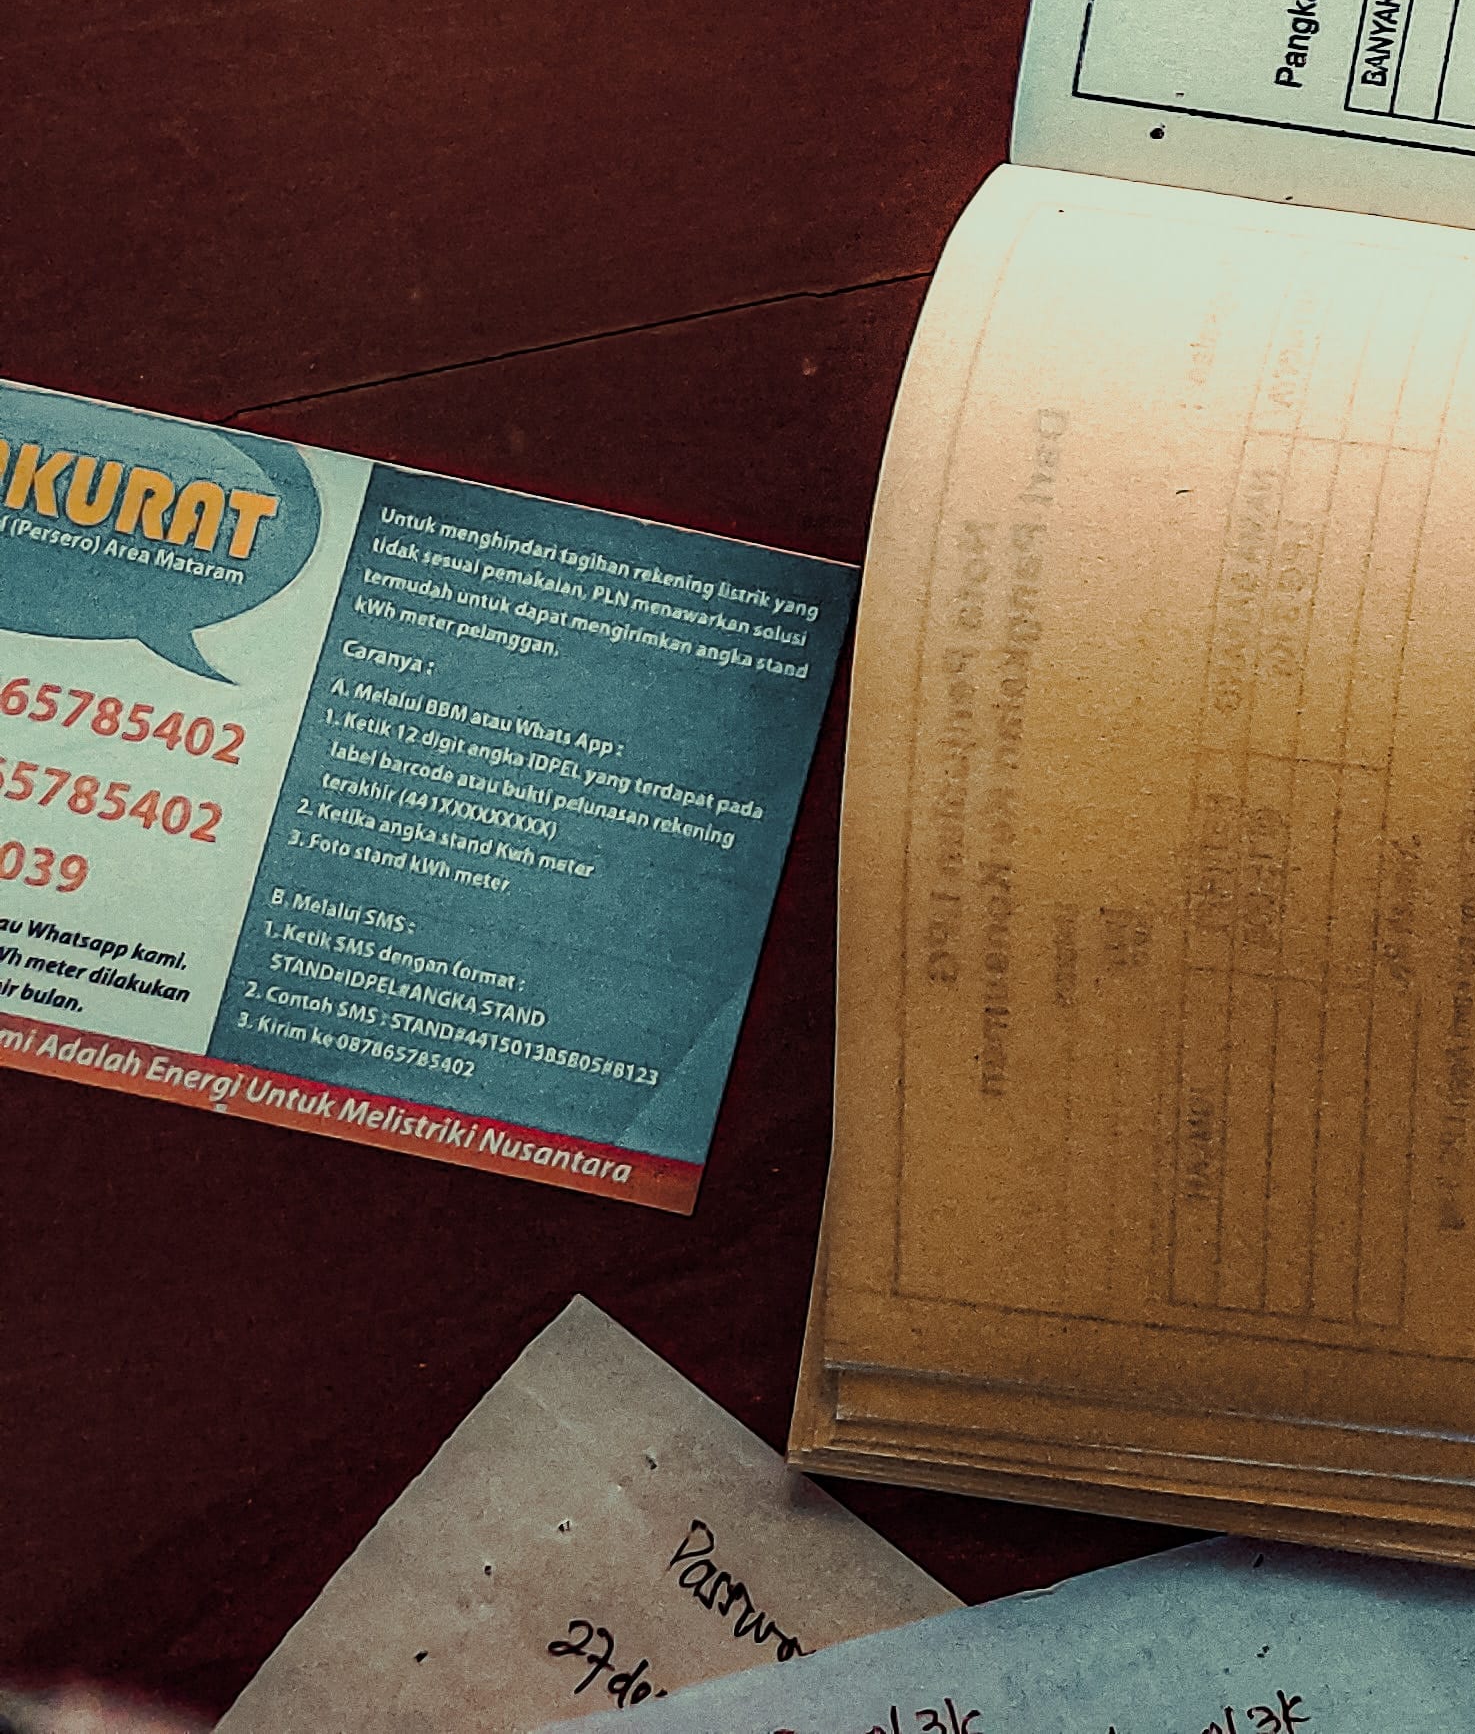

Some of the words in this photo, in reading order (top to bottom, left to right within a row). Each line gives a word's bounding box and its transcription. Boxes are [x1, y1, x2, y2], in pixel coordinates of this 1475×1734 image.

[0, 438, 281, 560] KURAT
[103, 539, 150, 564] Area
[154, 549, 243, 585] Mataram
[381, 507, 436, 533] Untuk
[439, 525, 557, 562] menghindari
[559, 549, 629, 578] tagihan
[634, 567, 714, 600] rekening
[772, 598, 818, 622] yang
[355, 595, 395, 620] kWh
[399, 610, 455, 633] meter
[592, 586, 629, 607] PLN
[631, 599, 749, 633] menawarkan
[753, 625, 807, 646] solusi
[343, 640, 422, 672] Caranya
[569, 617, 692, 653] mengirimkan
[695, 645, 752, 666] angka
[756, 658, 808, 678] stand
[425, 699, 467, 722] BBM
[516, 718, 571, 744] Whats
[28, 920, 128, 960] Whatsapp
[20, 983, 83, 1012] bulan.
[24, 957, 87, 979] meter
[89, 967, 190, 1002] dilakukan
[36, 1034, 141, 1076] Adalah
[146, 1057, 243, 1101] Energi
[246, 1077, 335, 1117] Untuk
[338, 1098, 478, 1147] Melistriki
[479, 1129, 631, 1182] Nusantara
